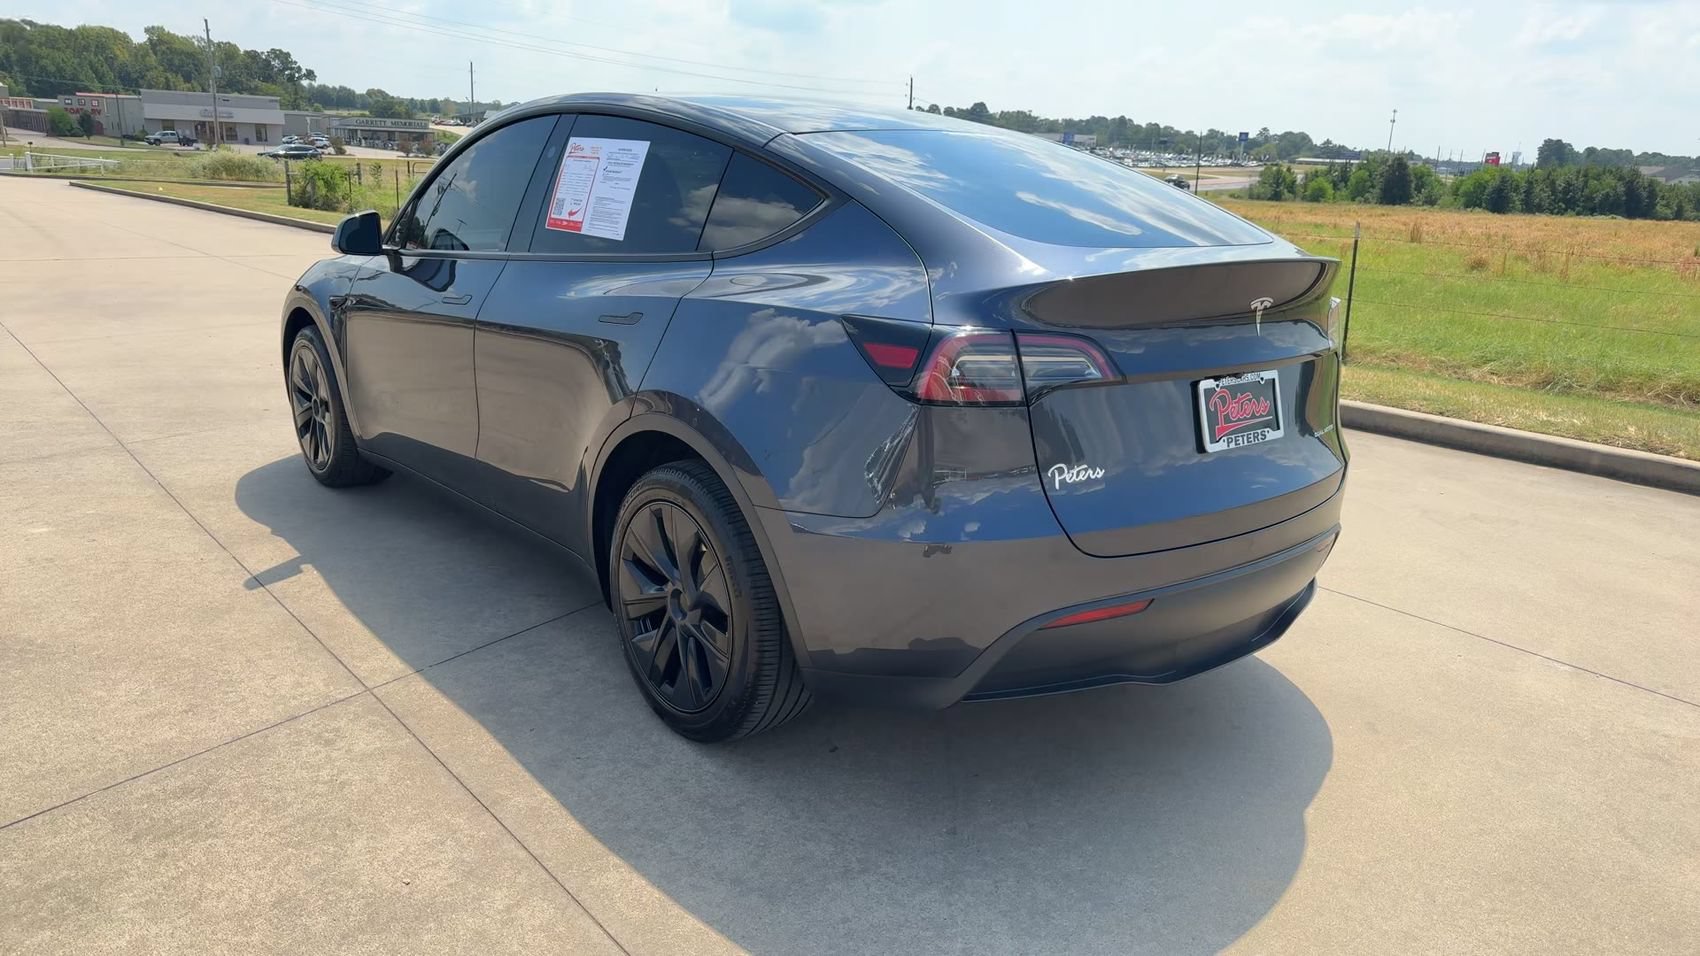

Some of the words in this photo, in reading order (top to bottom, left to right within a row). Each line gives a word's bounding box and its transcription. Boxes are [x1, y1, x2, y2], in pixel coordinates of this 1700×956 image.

[355, 118, 387, 127] GARRETT
[1209, 388, 1271, 428] Peters
[1047, 463, 1105, 490] Peters
